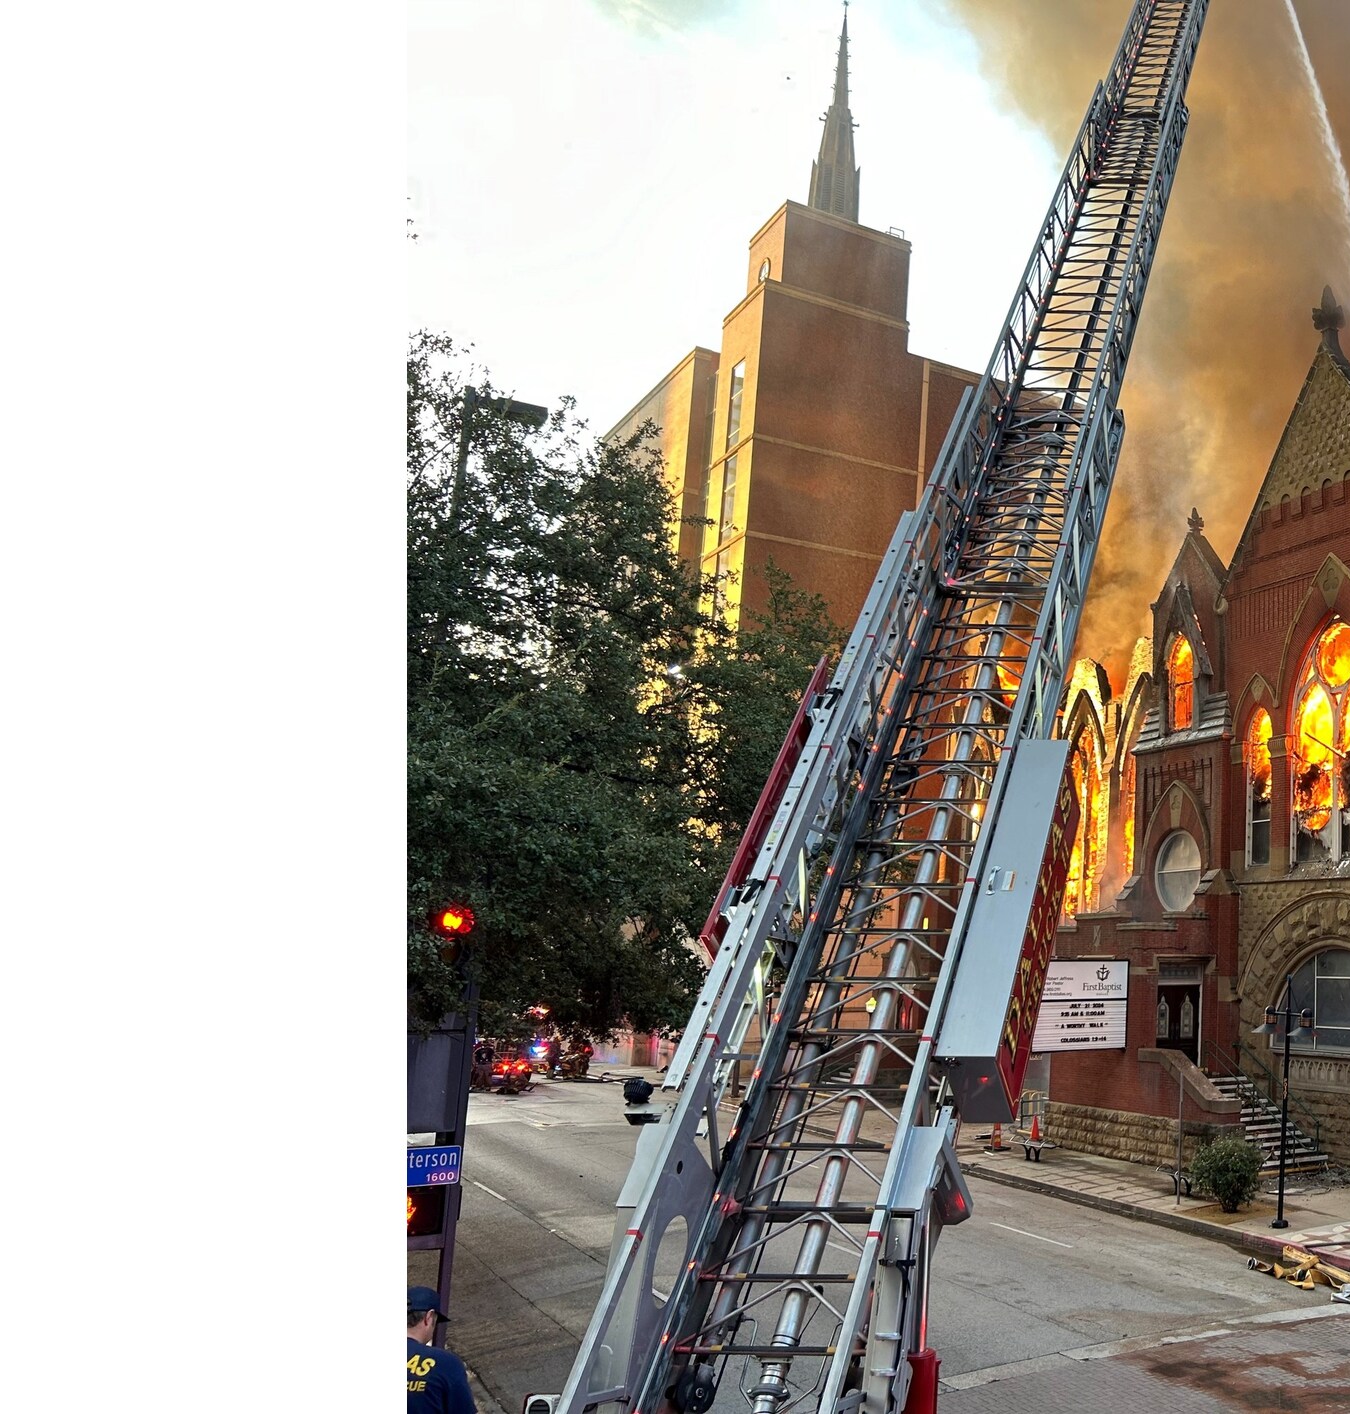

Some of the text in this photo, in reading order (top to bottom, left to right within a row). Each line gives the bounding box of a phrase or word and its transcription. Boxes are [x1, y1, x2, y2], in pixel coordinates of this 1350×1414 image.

[1004, 773, 1071, 1065] DALLAS
[1023, 876, 1062, 1036] TRUCK
[1082, 982, 1122, 996] First Baptist
[407, 1151, 458, 1169] terson
[425, 1171, 455, 1182] 1600
